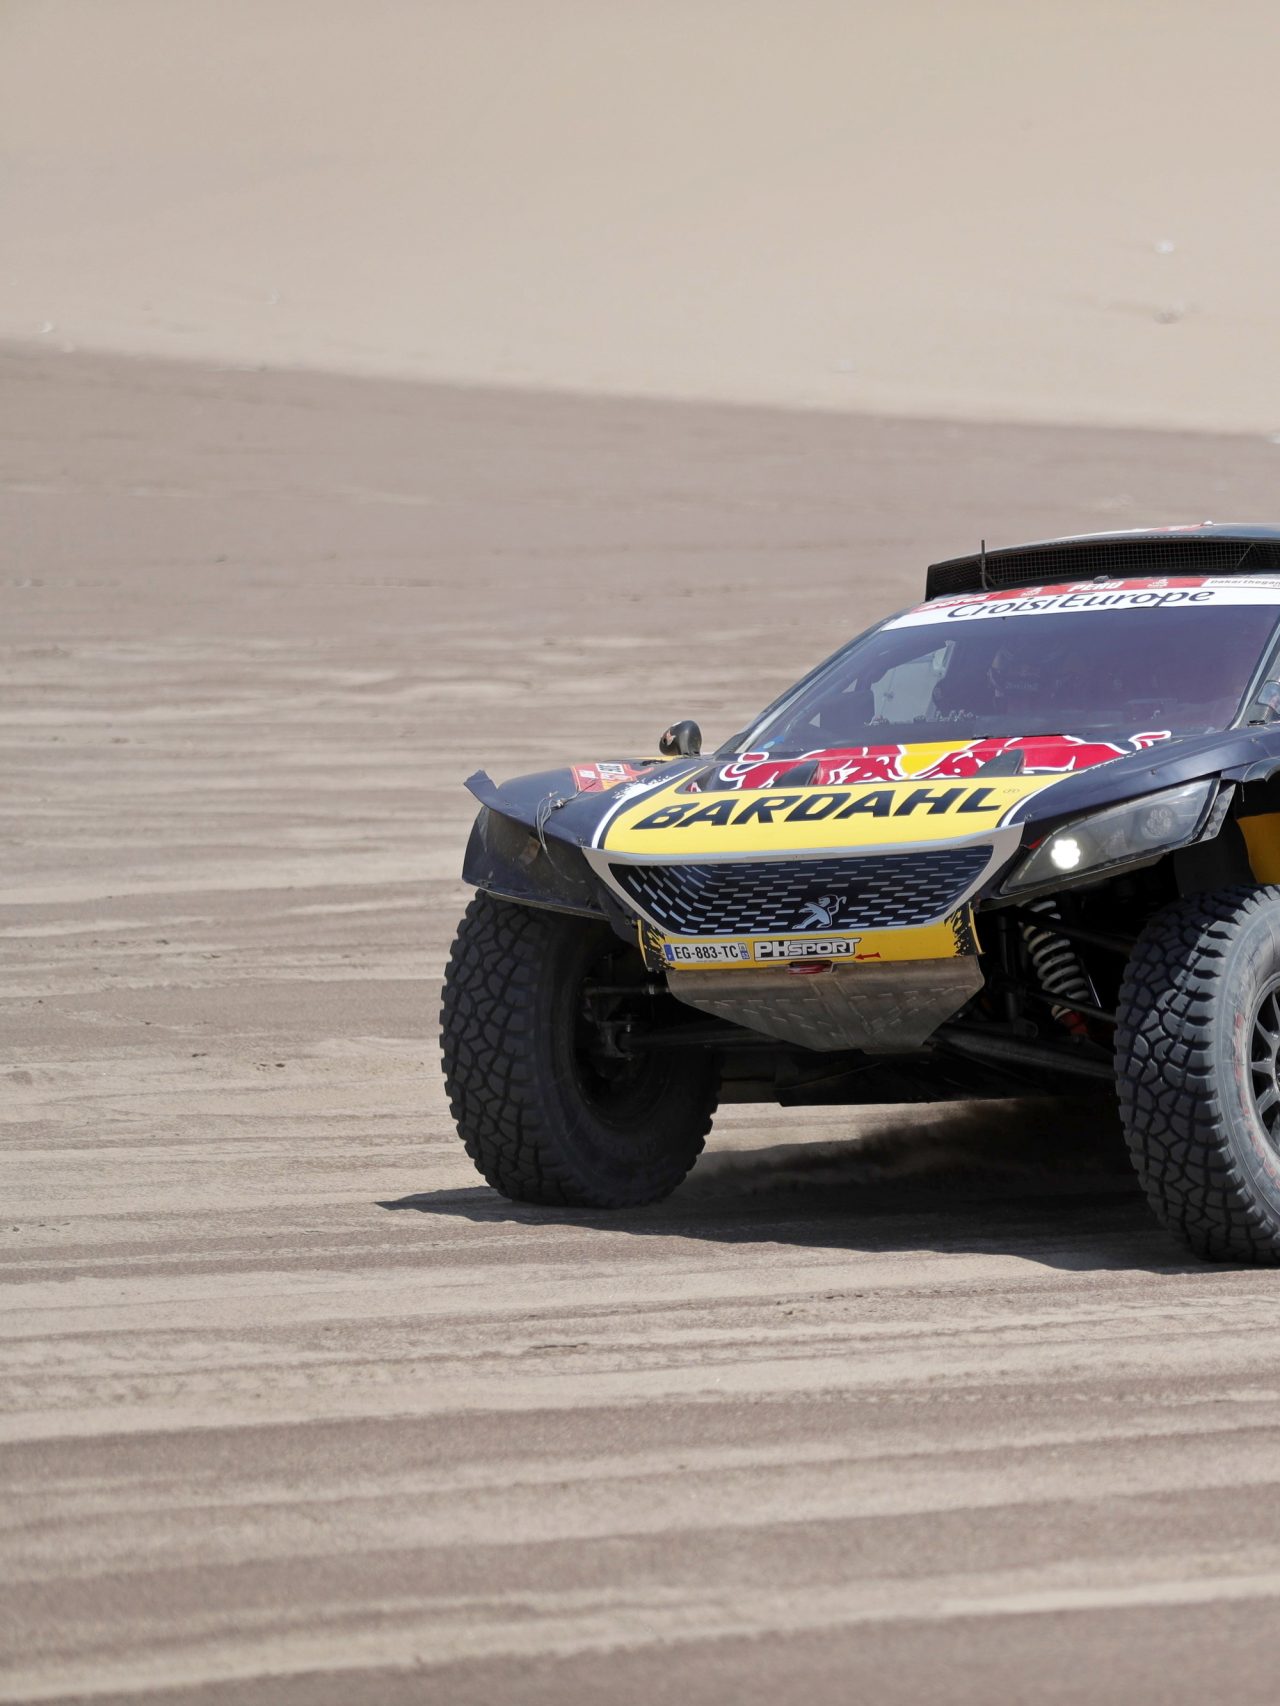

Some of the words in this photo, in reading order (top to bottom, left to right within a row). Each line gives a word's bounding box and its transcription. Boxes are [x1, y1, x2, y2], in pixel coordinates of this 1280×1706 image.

[947, 590, 1215, 619] CroisiEurope
[630, 787, 1003, 830] BARDAHL
[674, 944, 739, 960] EG-883-TC
